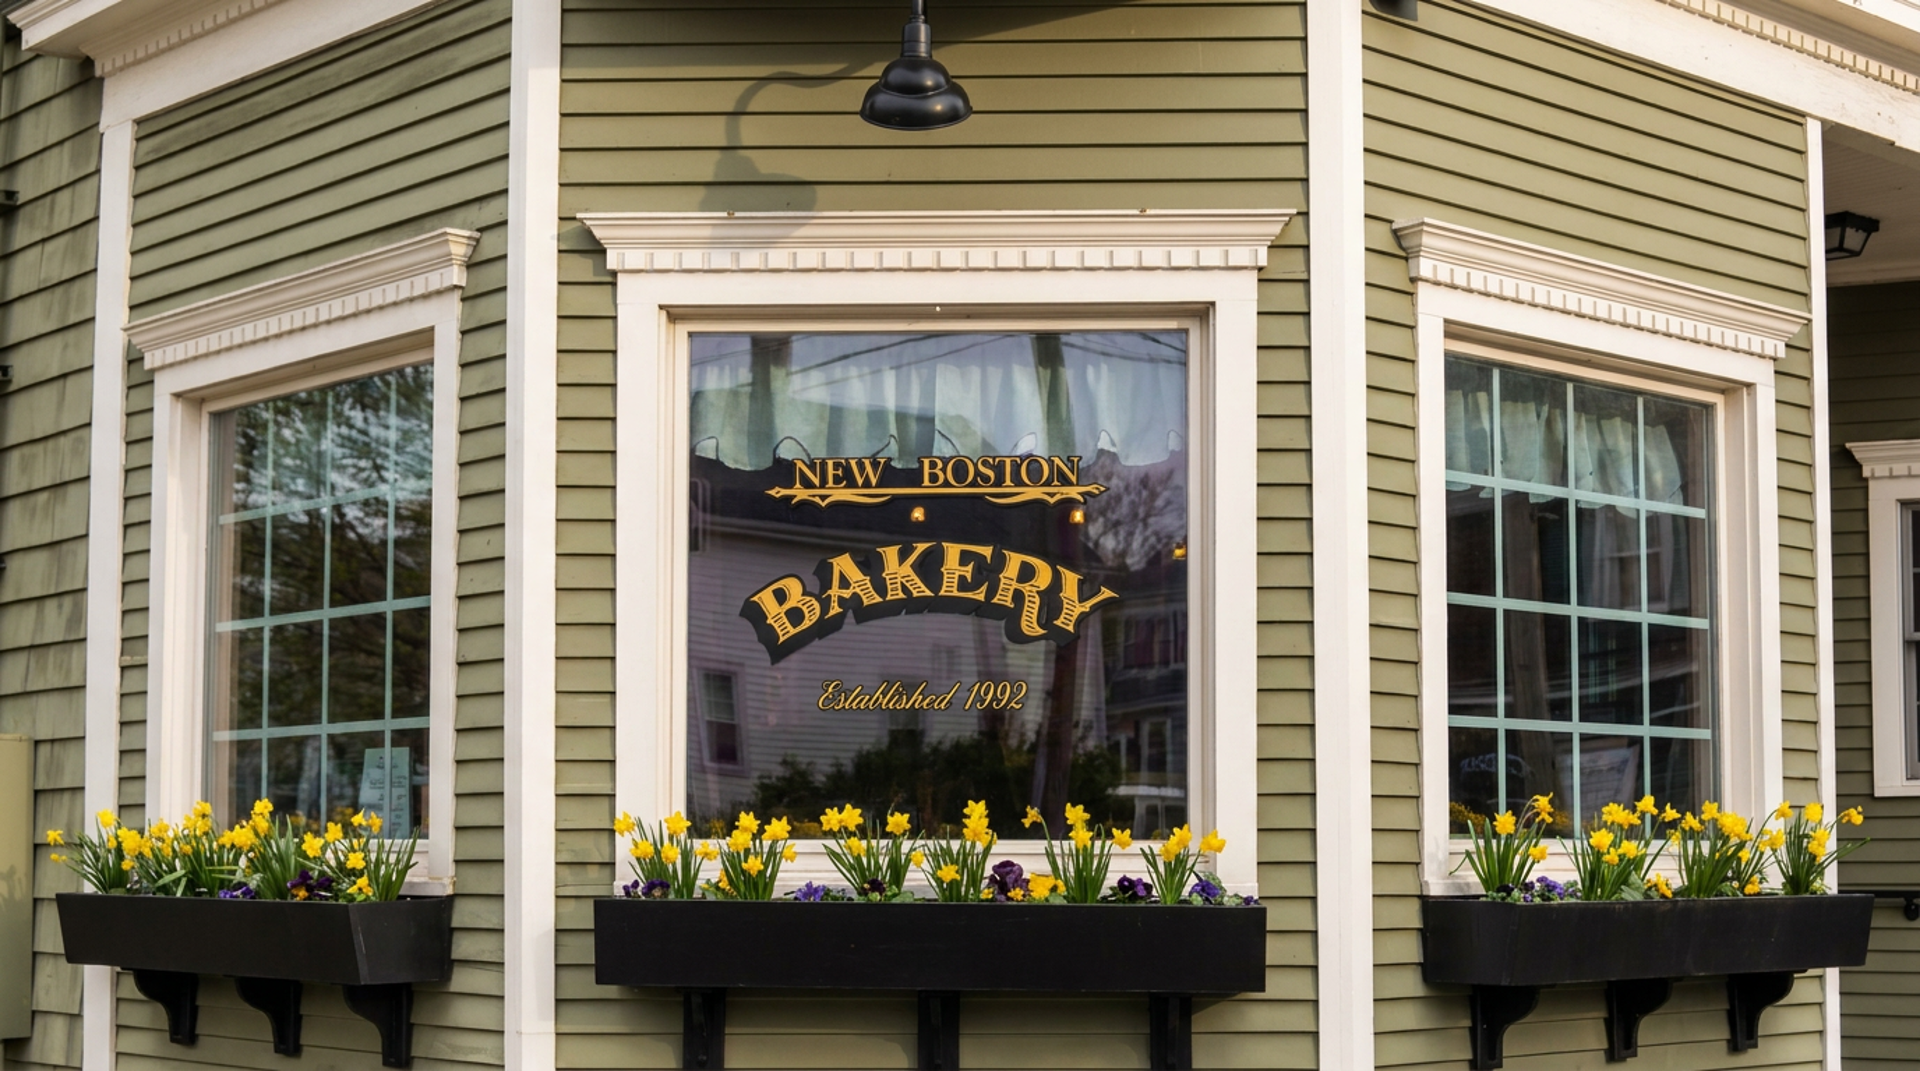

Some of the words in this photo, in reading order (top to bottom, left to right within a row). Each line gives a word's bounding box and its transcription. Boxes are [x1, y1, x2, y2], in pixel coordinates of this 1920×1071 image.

[793, 458, 891, 488] NEW
[920, 456, 1082, 487] BOSTON
[748, 541, 1120, 647] BAKERY
[818, 679, 961, 712] Established
[963, 680, 1029, 711] 1992
